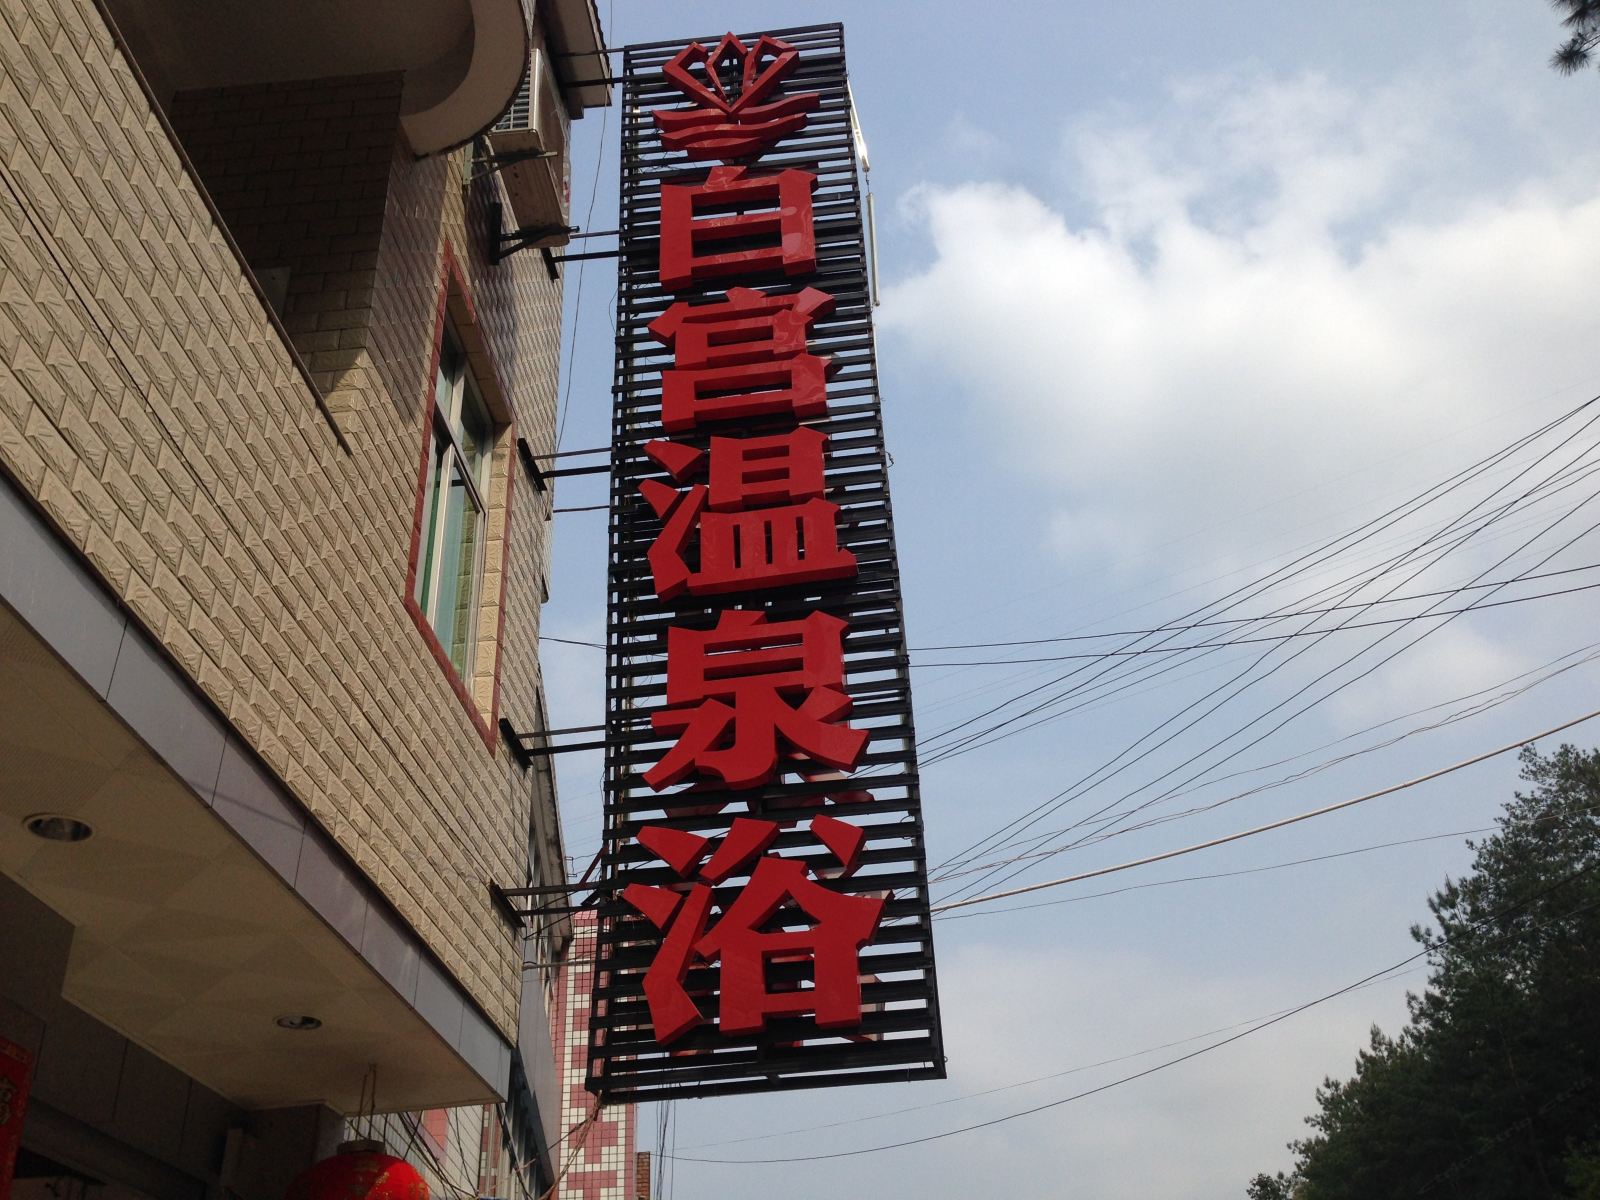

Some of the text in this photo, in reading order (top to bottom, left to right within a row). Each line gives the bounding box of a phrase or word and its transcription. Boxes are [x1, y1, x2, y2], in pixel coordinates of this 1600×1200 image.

[622, 164, 890, 1044] 白宫温泉浴
